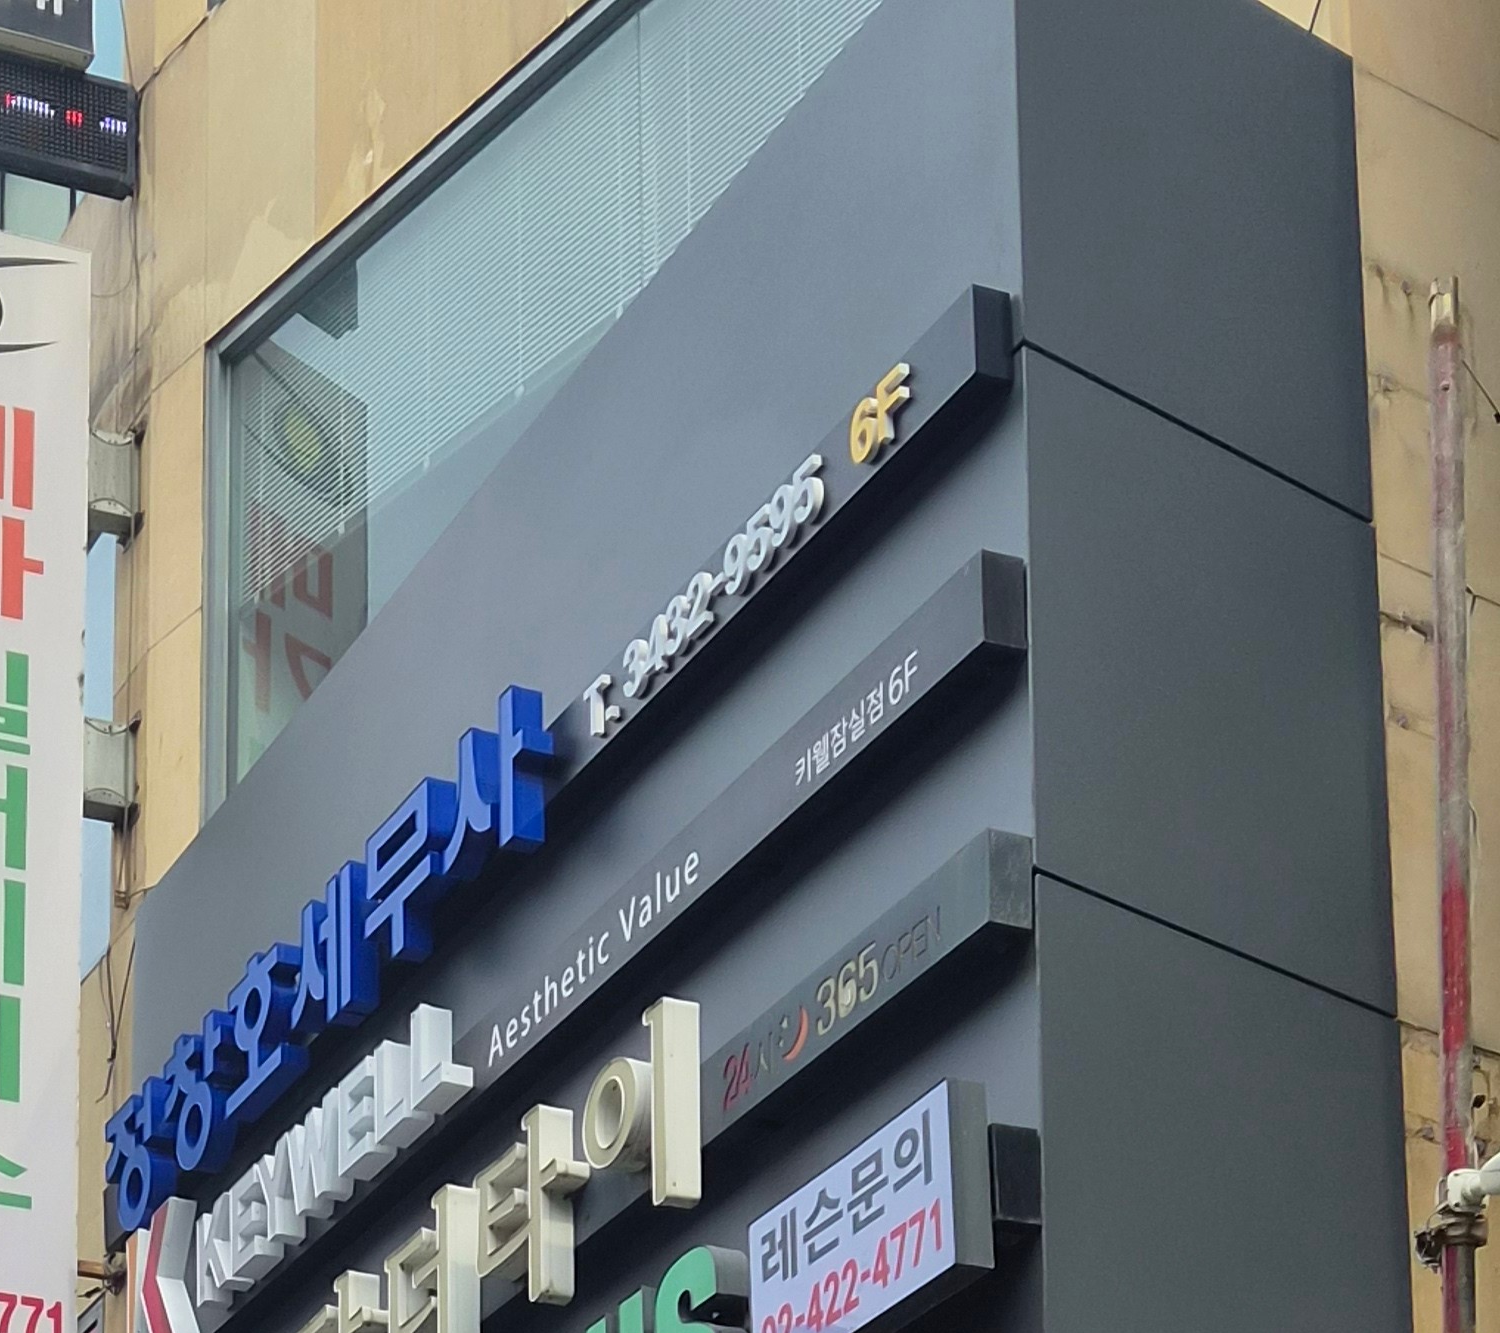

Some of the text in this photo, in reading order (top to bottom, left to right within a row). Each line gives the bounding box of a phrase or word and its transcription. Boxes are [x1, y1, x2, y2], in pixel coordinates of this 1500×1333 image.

[104, 684, 555, 1234] 정창호세무사
[621, 453, 826, 689] 3432-9595
[848, 361, 912, 466] 6F
[794, 649, 921, 790] 키웰잠실점 6F
[815, 941, 880, 1037] 365
[196, 1002, 475, 1309] KEYWELL
[487, 926, 612, 1063] Aesthetic
[617, 847, 702, 946] Value
[760, 1108, 934, 1284] 레슨문의
